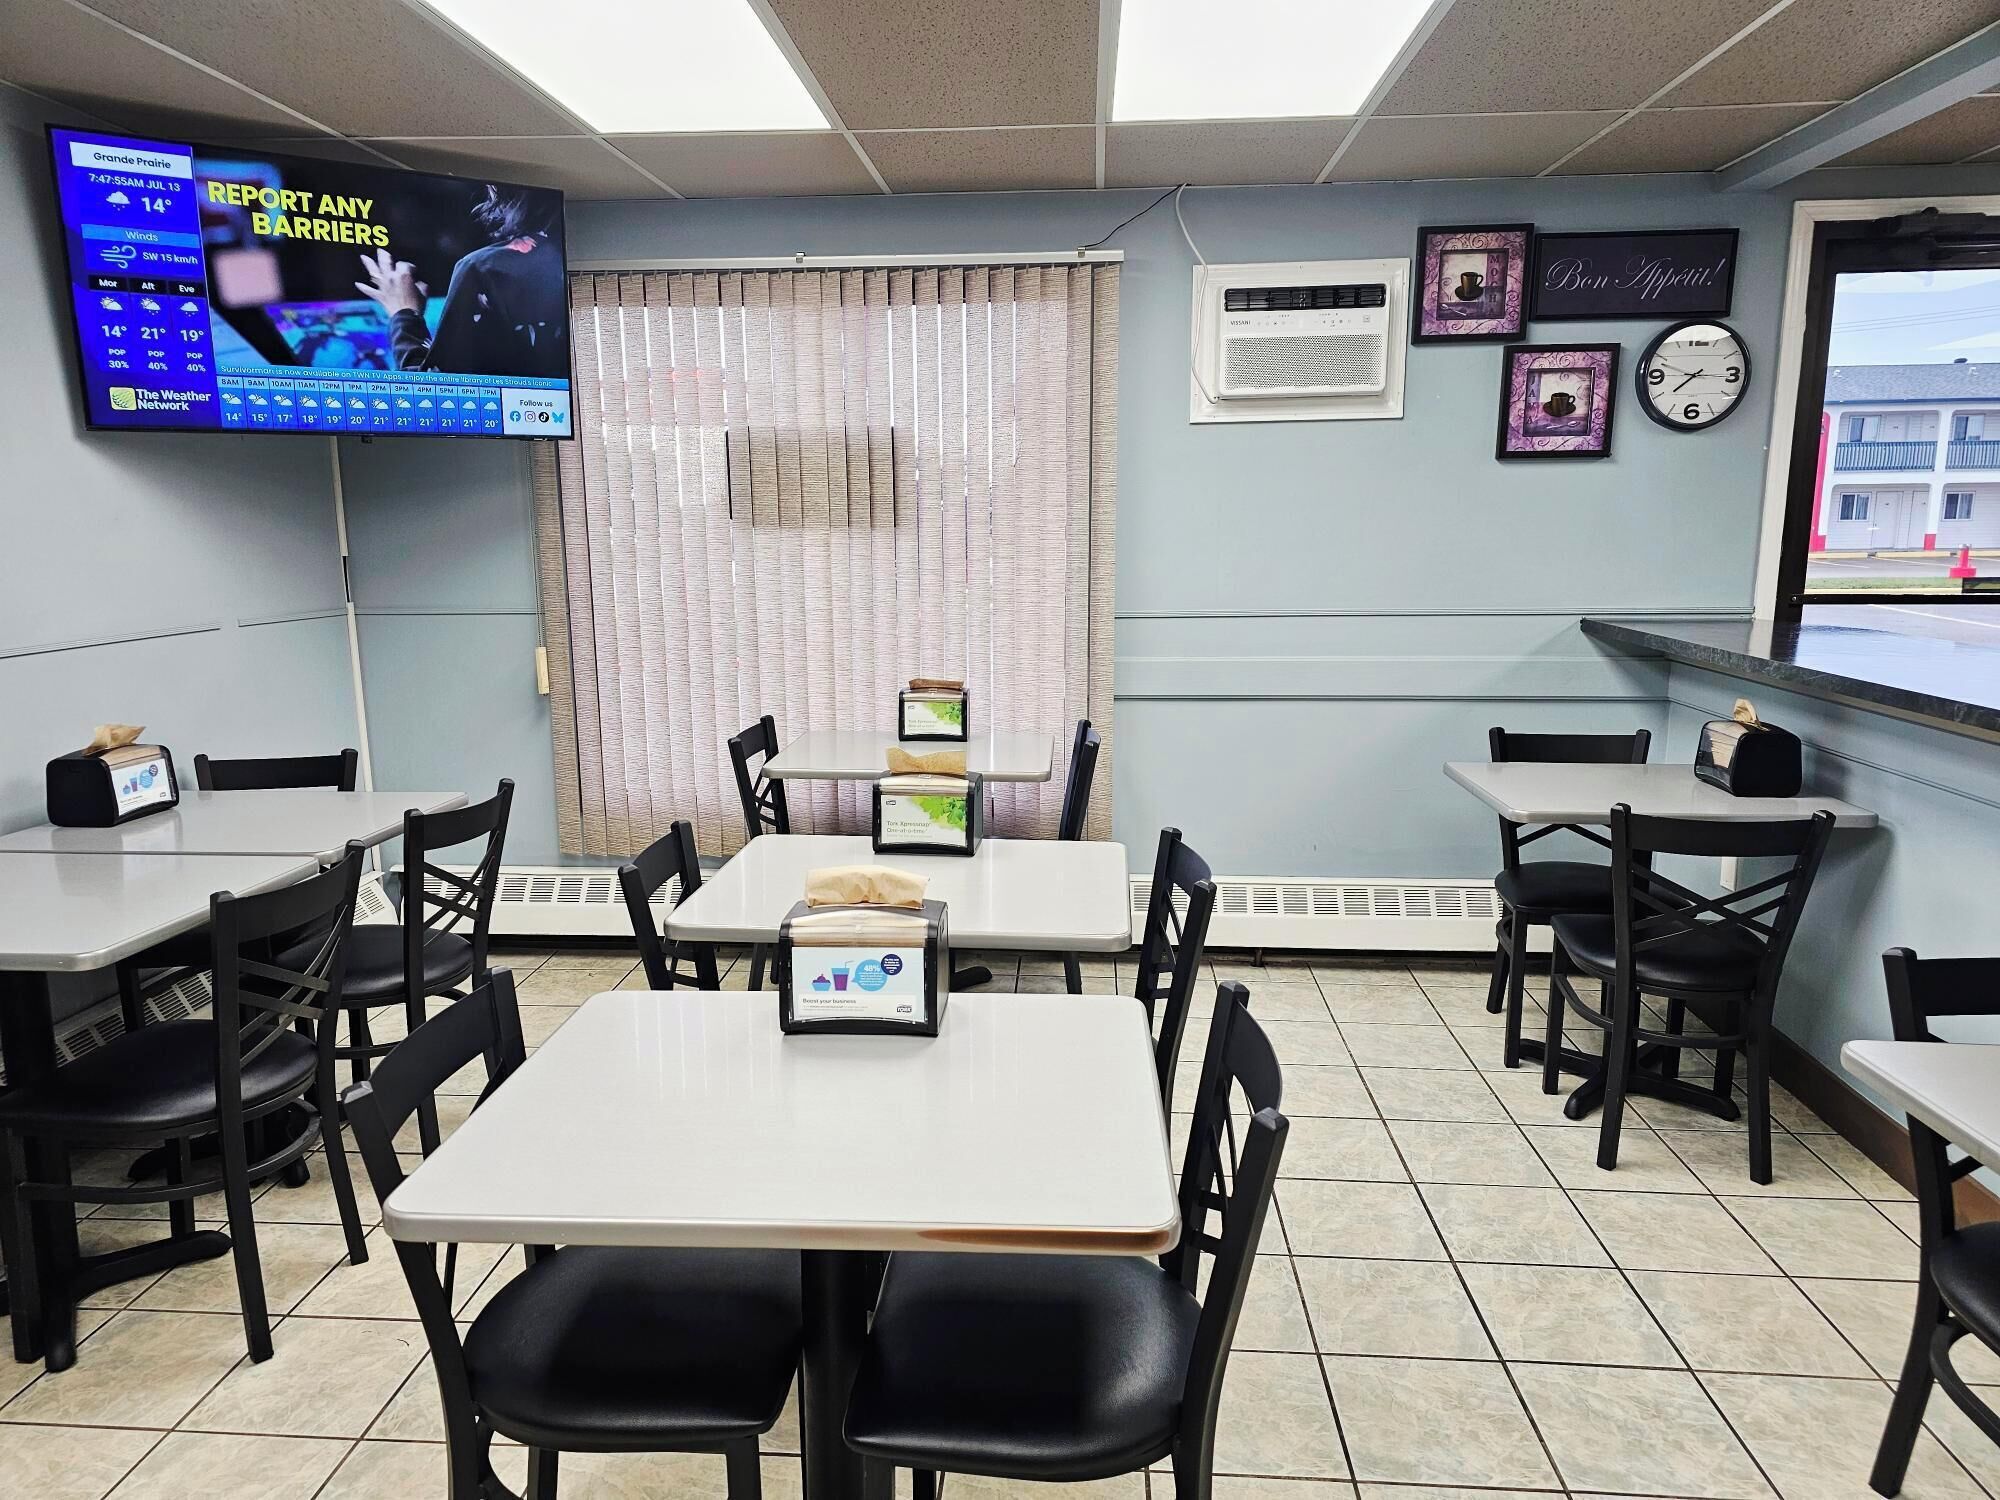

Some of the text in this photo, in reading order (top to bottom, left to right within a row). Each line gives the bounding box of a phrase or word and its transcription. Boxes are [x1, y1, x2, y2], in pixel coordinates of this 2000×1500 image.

[93, 152, 171, 169] Grande Prairie
[88, 173, 181, 192] 7:47:55AM JUL 13
[141, 197, 172, 214] 14°
[207, 180, 373, 220] REPORT ANY
[125, 230, 159, 241] Winds
[252, 211, 390, 247] BARRIERS
[142, 252, 199, 265] SW 15 km/h
[1545, 254, 1726, 300] Bon Appétit!
[98, 279, 195, 293] Mor Aft Eve
[101, 325, 204, 342] 14° 21° 19°
[108, 348, 126, 356] POP
[108, 360, 206, 372] 30% 40% 40%
[221, 366, 274, 375] Survivorman
[302, 370, 339, 378] available
[1725, 366, 1741, 383] 3
[1648, 368, 1665, 385] 9
[297, 381, 316, 389] 11AM
[322, 382, 340, 390] 12PM
[135, 389, 211, 402] The Weather
[137, 400, 189, 411] Network
[1683, 403, 1700, 420] 6
